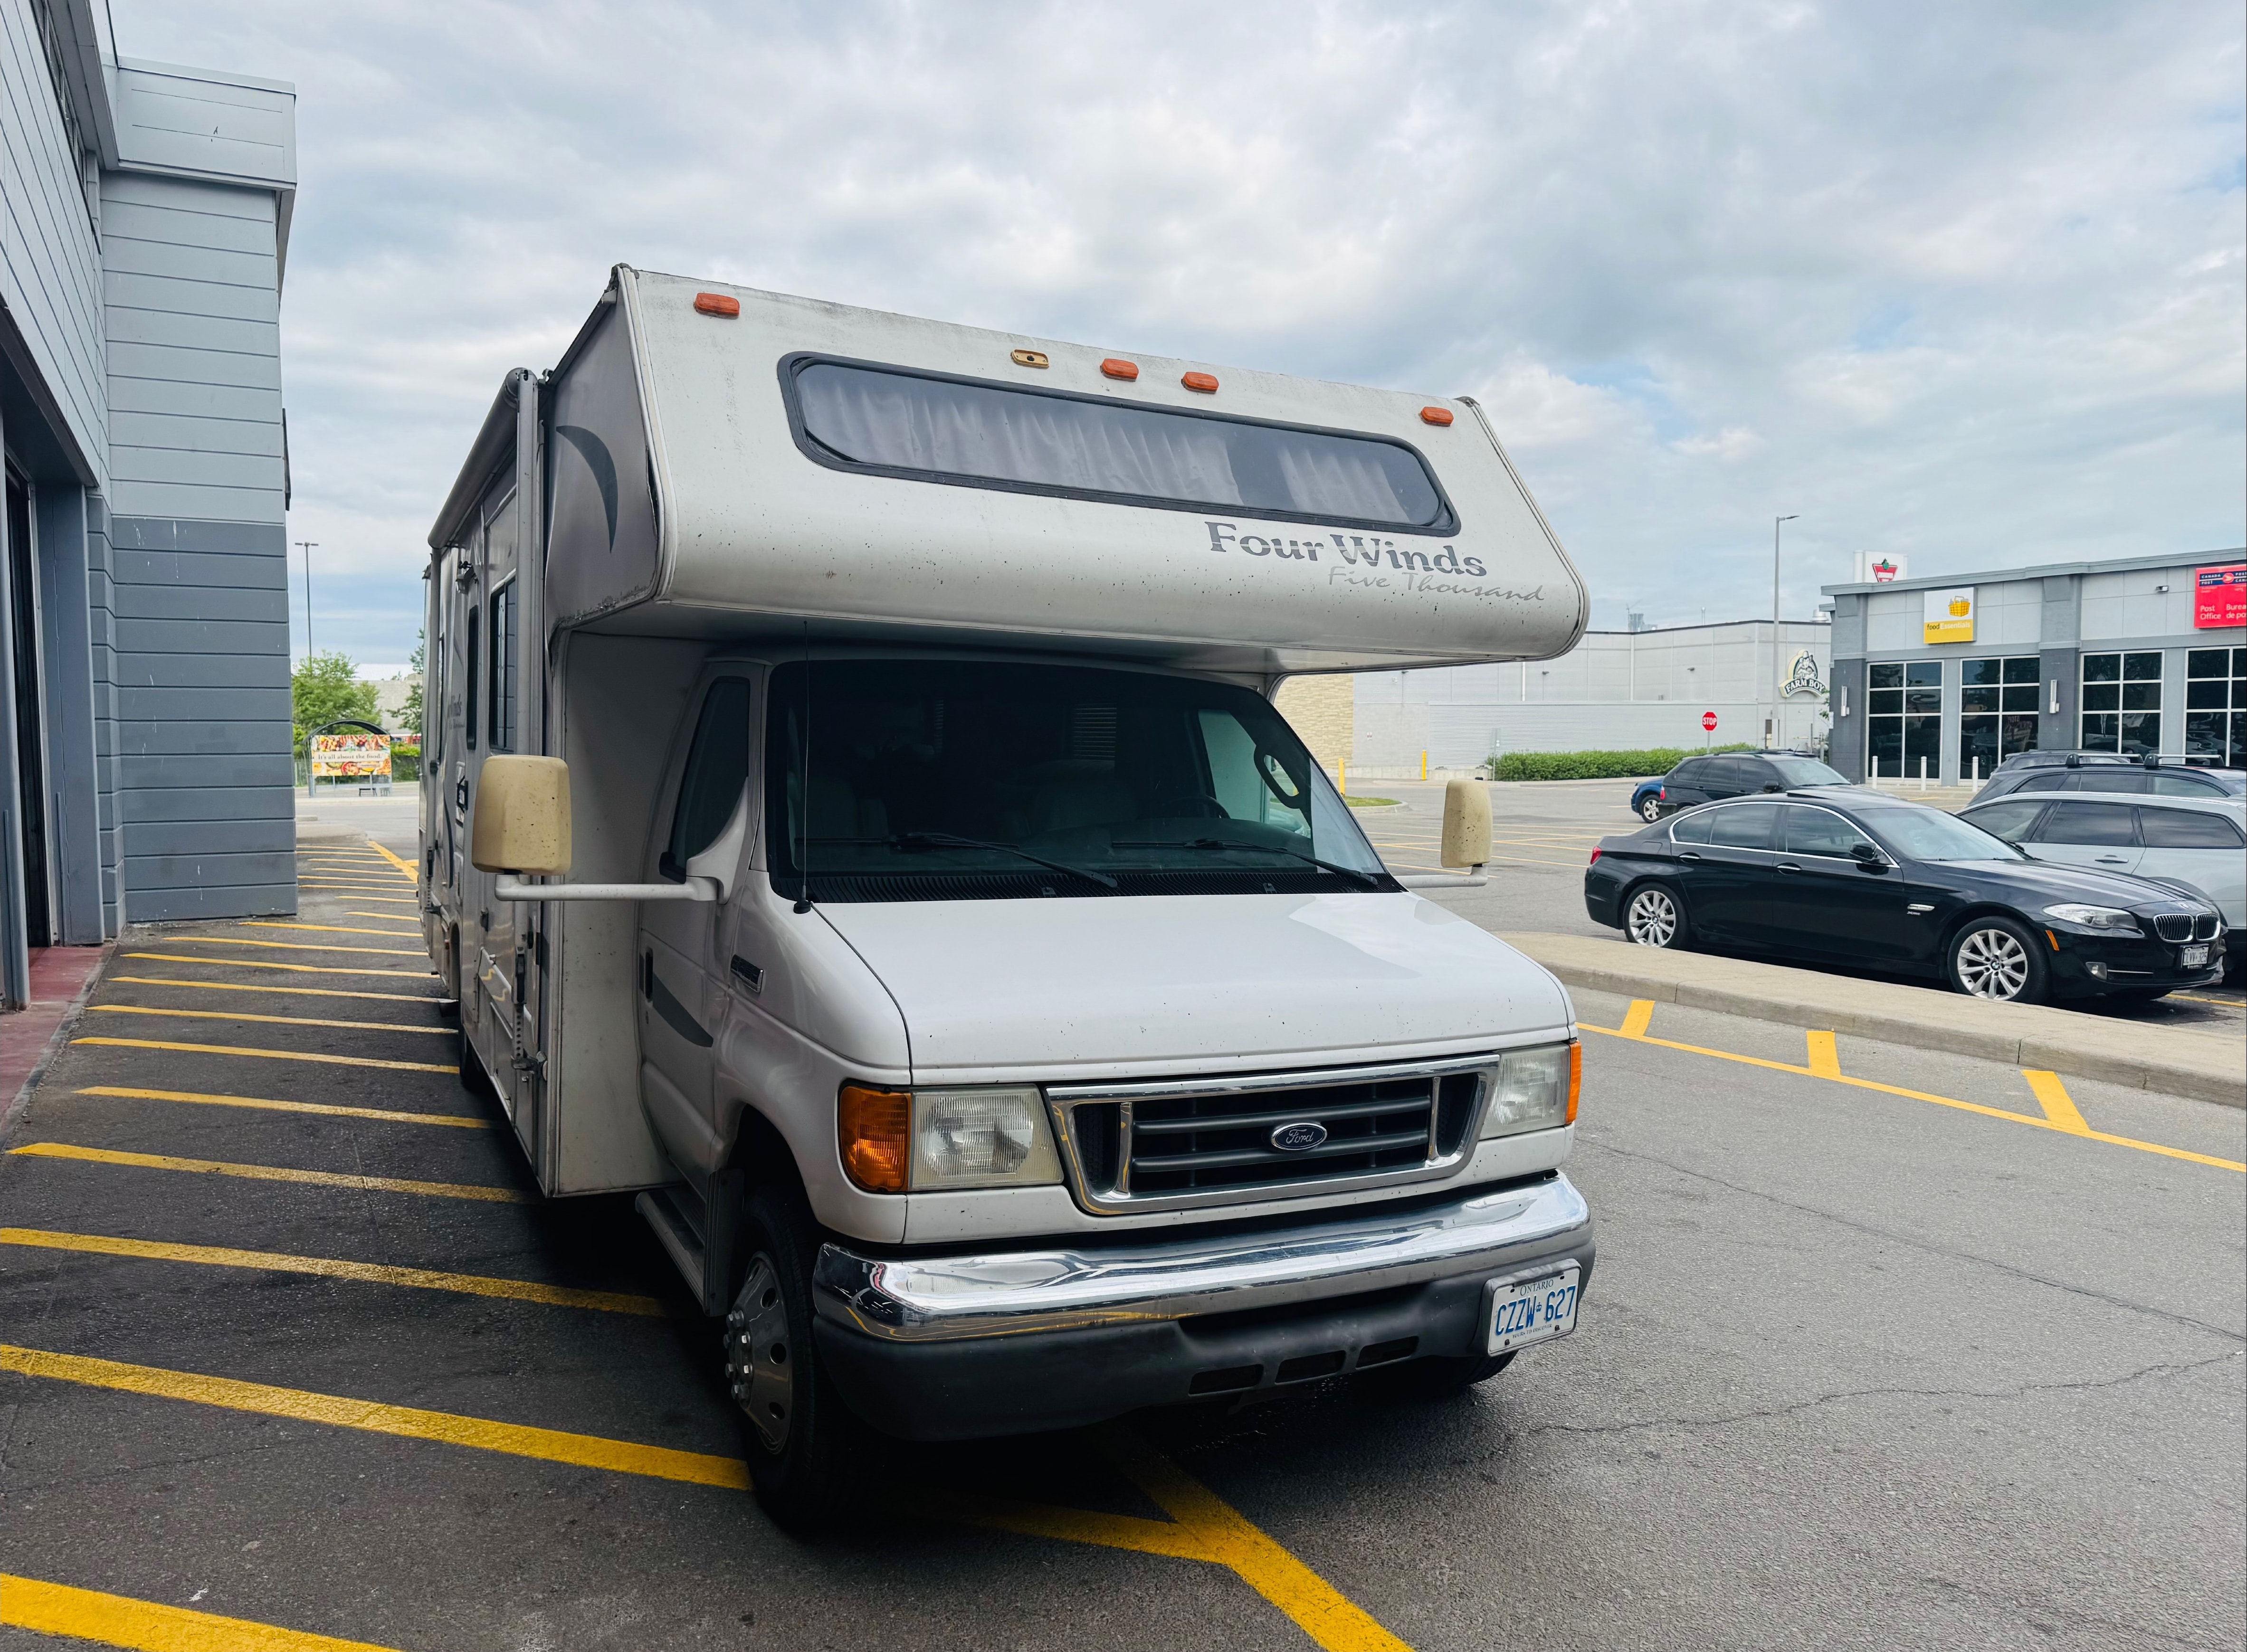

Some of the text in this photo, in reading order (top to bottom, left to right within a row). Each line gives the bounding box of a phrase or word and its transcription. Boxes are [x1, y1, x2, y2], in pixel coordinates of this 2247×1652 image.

[1204, 522, 1487, 577] Four Winds
[1328, 566, 1545, 601] Five Thousand
[1940, 621, 1971, 629] Essentials
[1785, 679, 1825, 693] FARM BOY
[1703, 717, 1717, 726] STOP
[1285, 1129, 1314, 1144] Ford
[1520, 1279, 1553, 1296] ONTARIO
[1495, 1285, 1576, 1336] CZZW 627
[1533, 1323, 1552, 1333] DISCOVER
